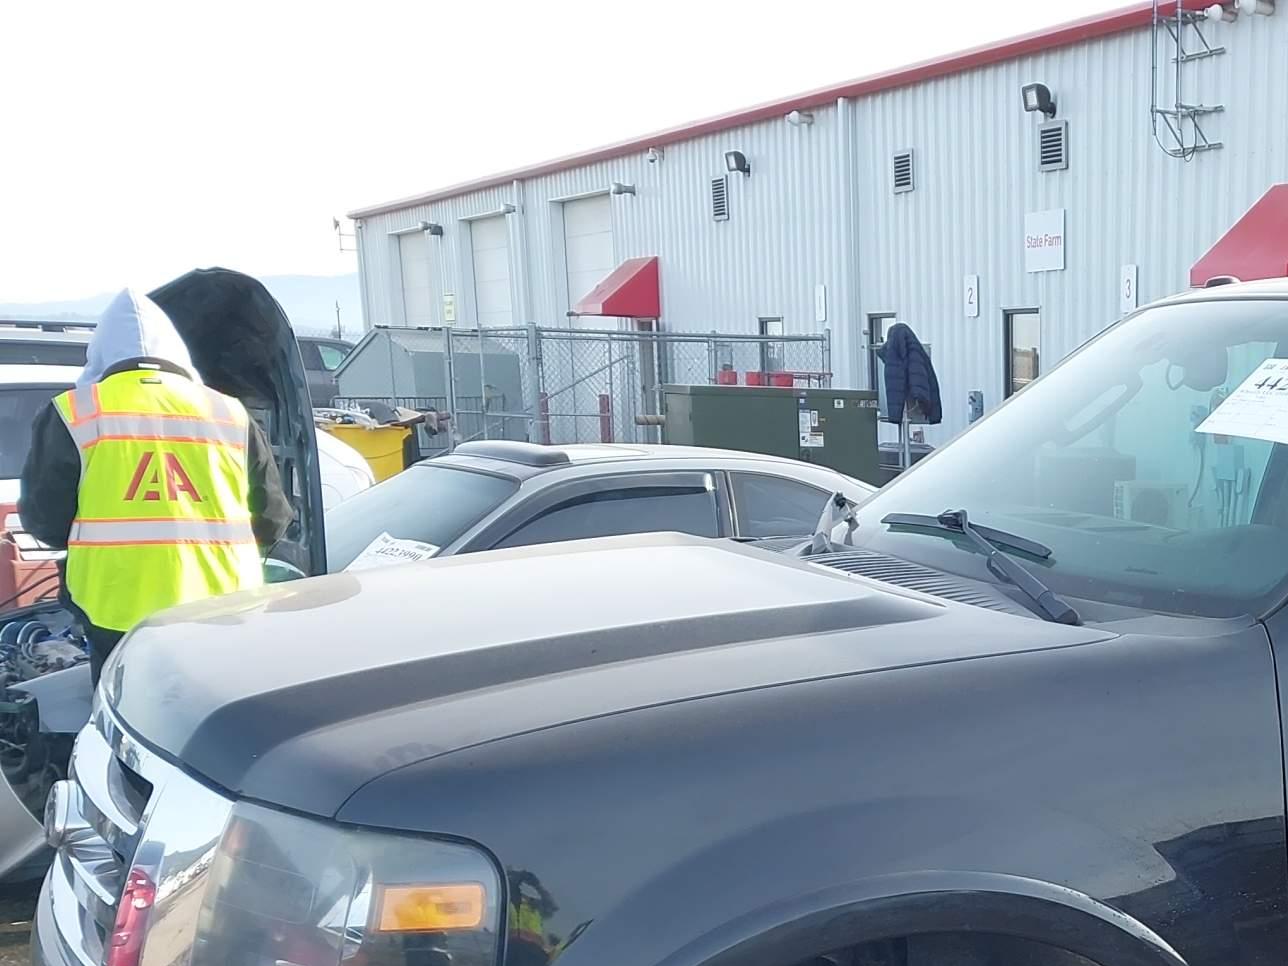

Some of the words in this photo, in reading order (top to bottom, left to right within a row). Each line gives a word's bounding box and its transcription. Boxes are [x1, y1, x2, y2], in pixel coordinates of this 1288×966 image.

[1026, 235, 1042, 248] State
[1044, 233, 1062, 247] Farm
[967, 287, 974, 305] 2
[1124, 278, 1131, 299] 3
